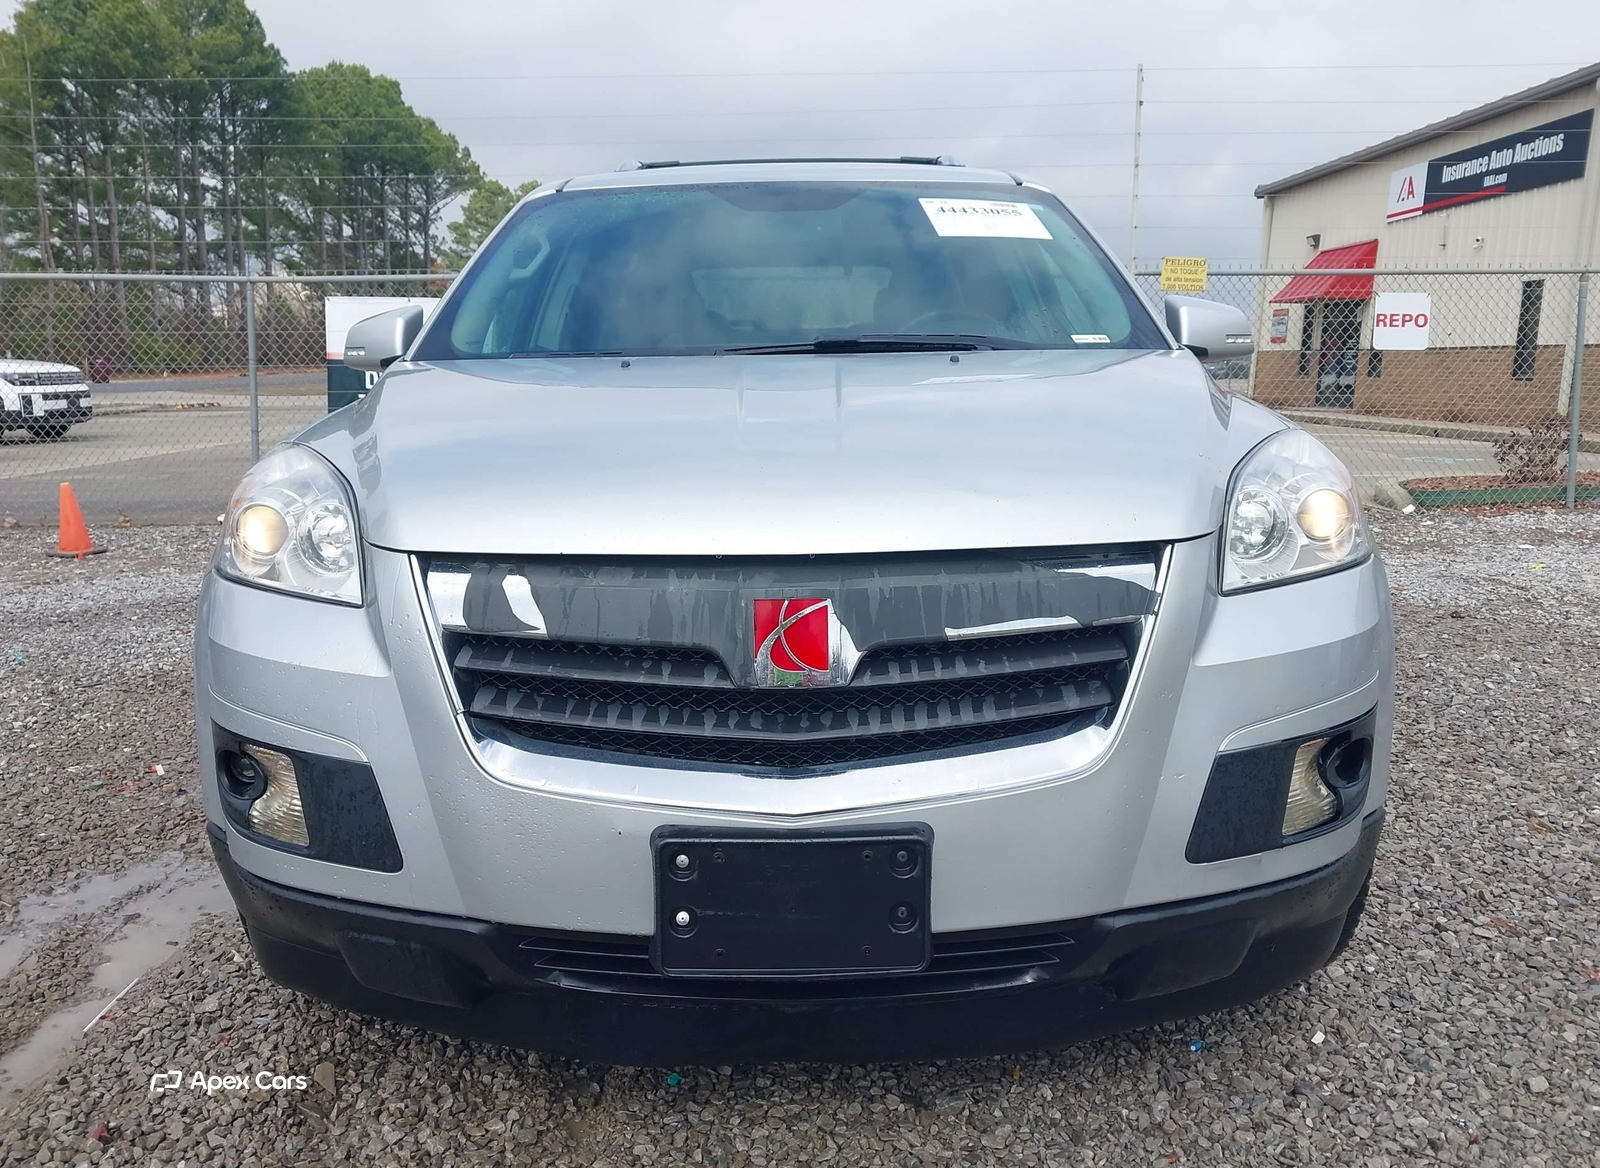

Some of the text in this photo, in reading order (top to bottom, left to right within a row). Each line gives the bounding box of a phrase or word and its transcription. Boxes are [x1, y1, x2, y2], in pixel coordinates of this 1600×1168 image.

[1441, 133, 1565, 183] Insurance Auto Auctions
[936, 206, 1023, 217] 44433055
[1165, 258, 1206, 267] PELIGRO
[1375, 313, 1429, 328] REPO
